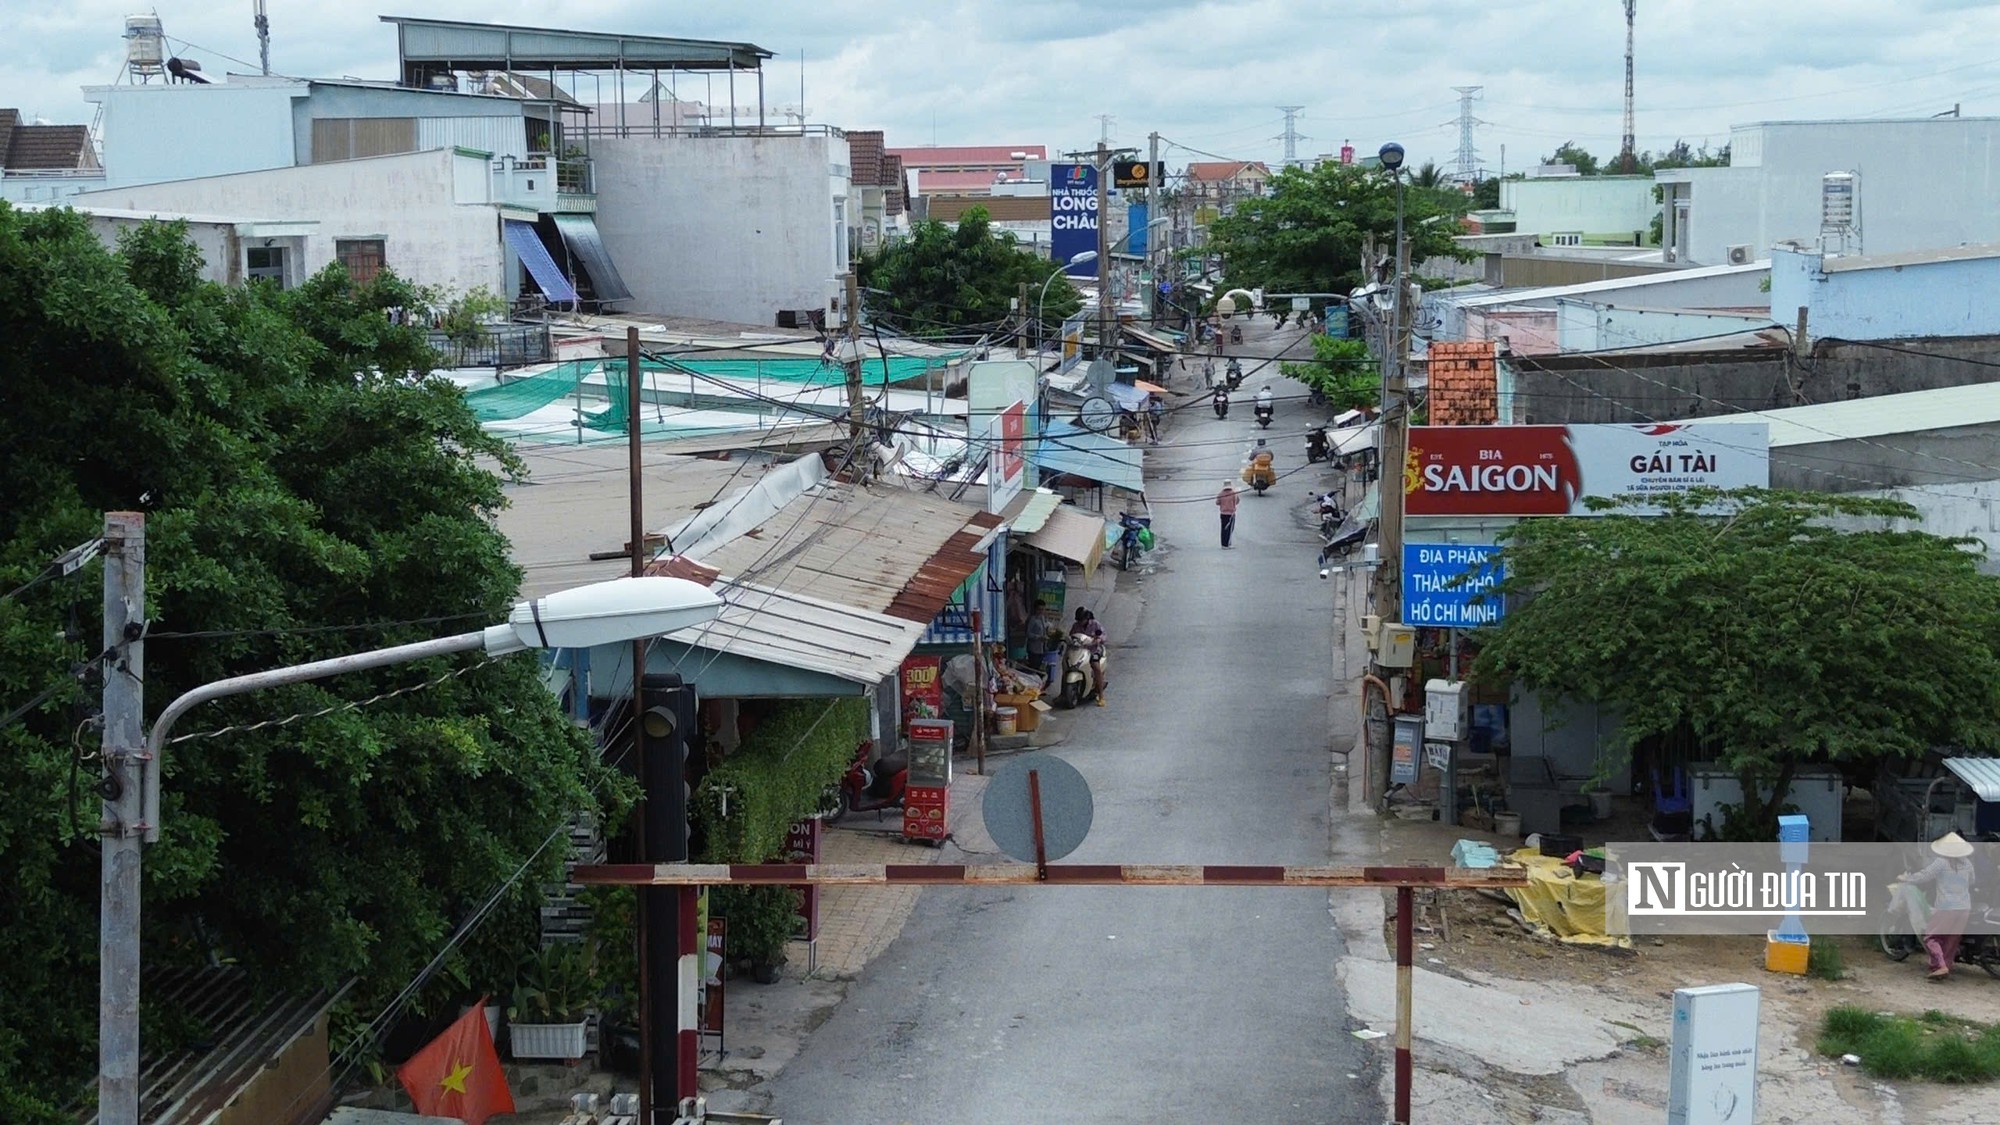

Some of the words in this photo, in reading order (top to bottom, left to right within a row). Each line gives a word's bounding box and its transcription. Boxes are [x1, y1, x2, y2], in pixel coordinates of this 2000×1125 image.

[1053, 196, 1098, 211] LONG
[1479, 450, 1503, 460] BIA
[1630, 449, 1671, 473] GÁI
[1679, 449, 1716, 473] TÀI
[1424, 464, 1558, 492] SAIGON
[1419, 549, 1444, 567] ĐỊA
[1411, 597, 1430, 621] HỒ
[1434, 599, 1458, 622] CHÍ
[1461, 604, 1497, 622] MINH
